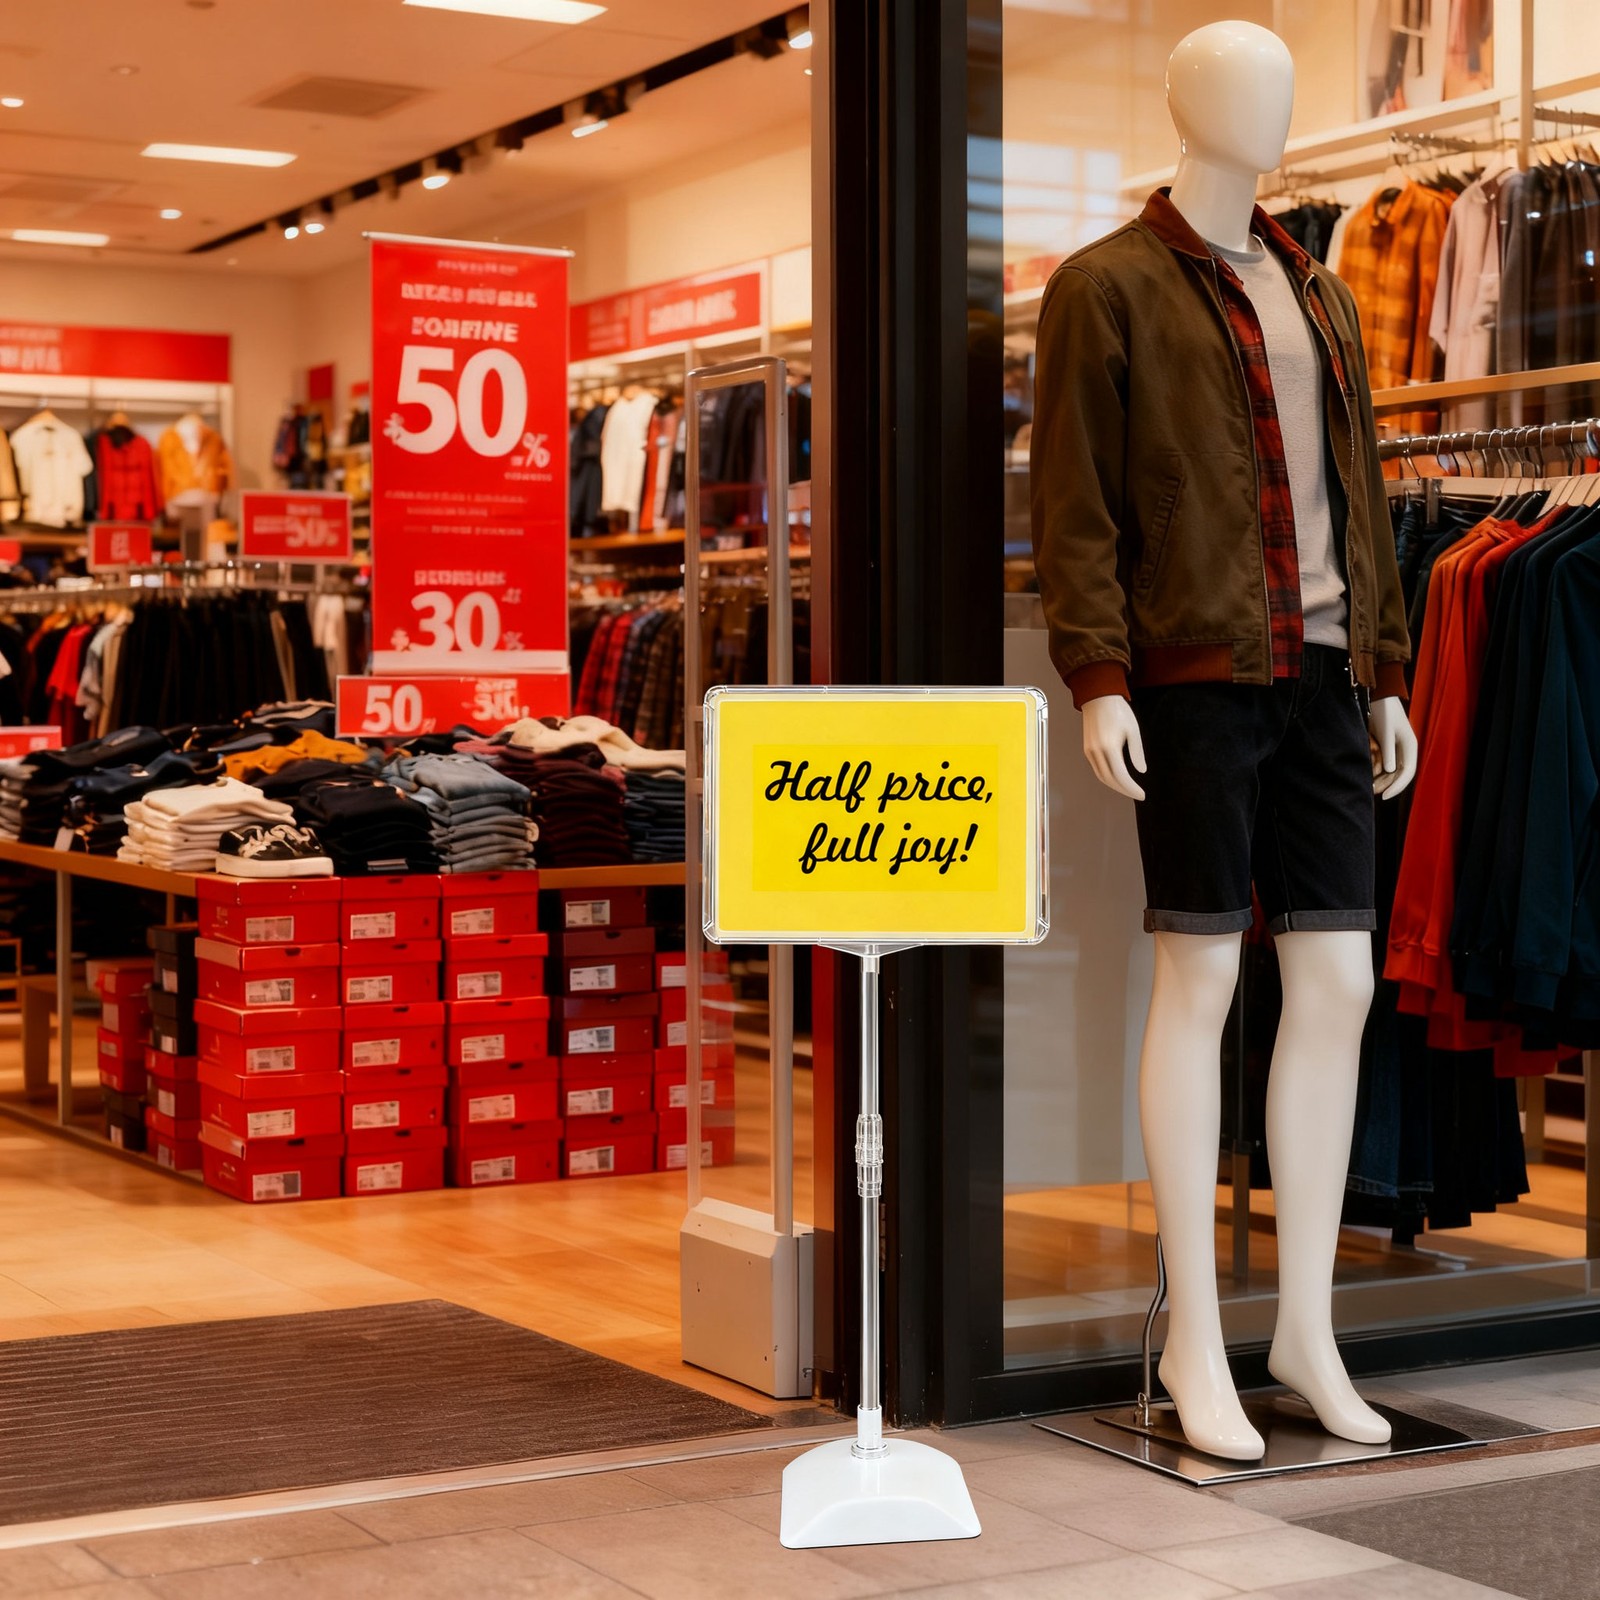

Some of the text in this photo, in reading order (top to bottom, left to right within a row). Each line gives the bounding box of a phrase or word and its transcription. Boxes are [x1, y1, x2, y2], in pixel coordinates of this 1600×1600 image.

[764, 760, 993, 814] Half price,
[798, 822, 979, 875] full joy!
